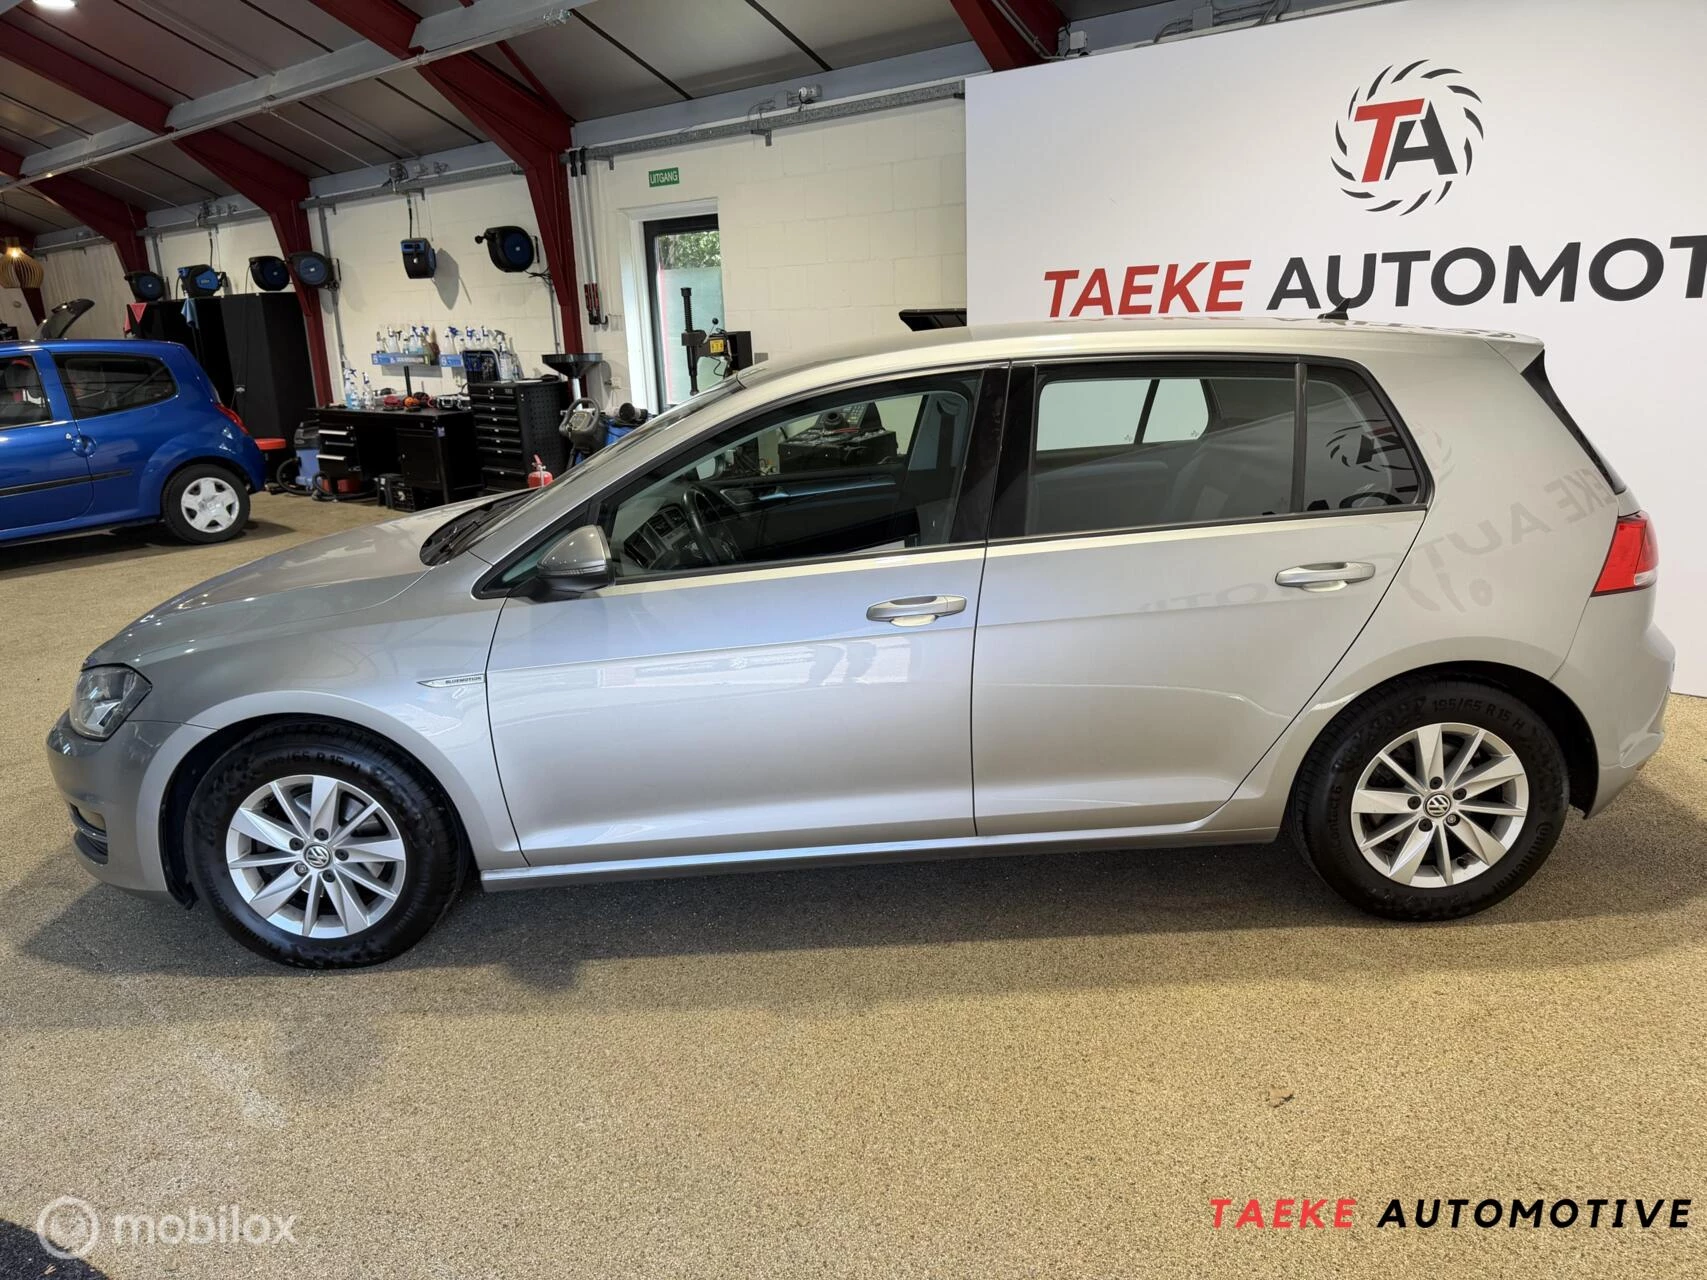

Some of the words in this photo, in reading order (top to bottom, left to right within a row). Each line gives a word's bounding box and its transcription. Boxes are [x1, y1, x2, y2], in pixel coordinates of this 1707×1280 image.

[650, 170, 678, 185] UITGANG
[1354, 98, 1458, 184] TA
[1043, 259, 1252, 318] TAEKE
[1266, 234, 1707, 311] AUTOMOT
